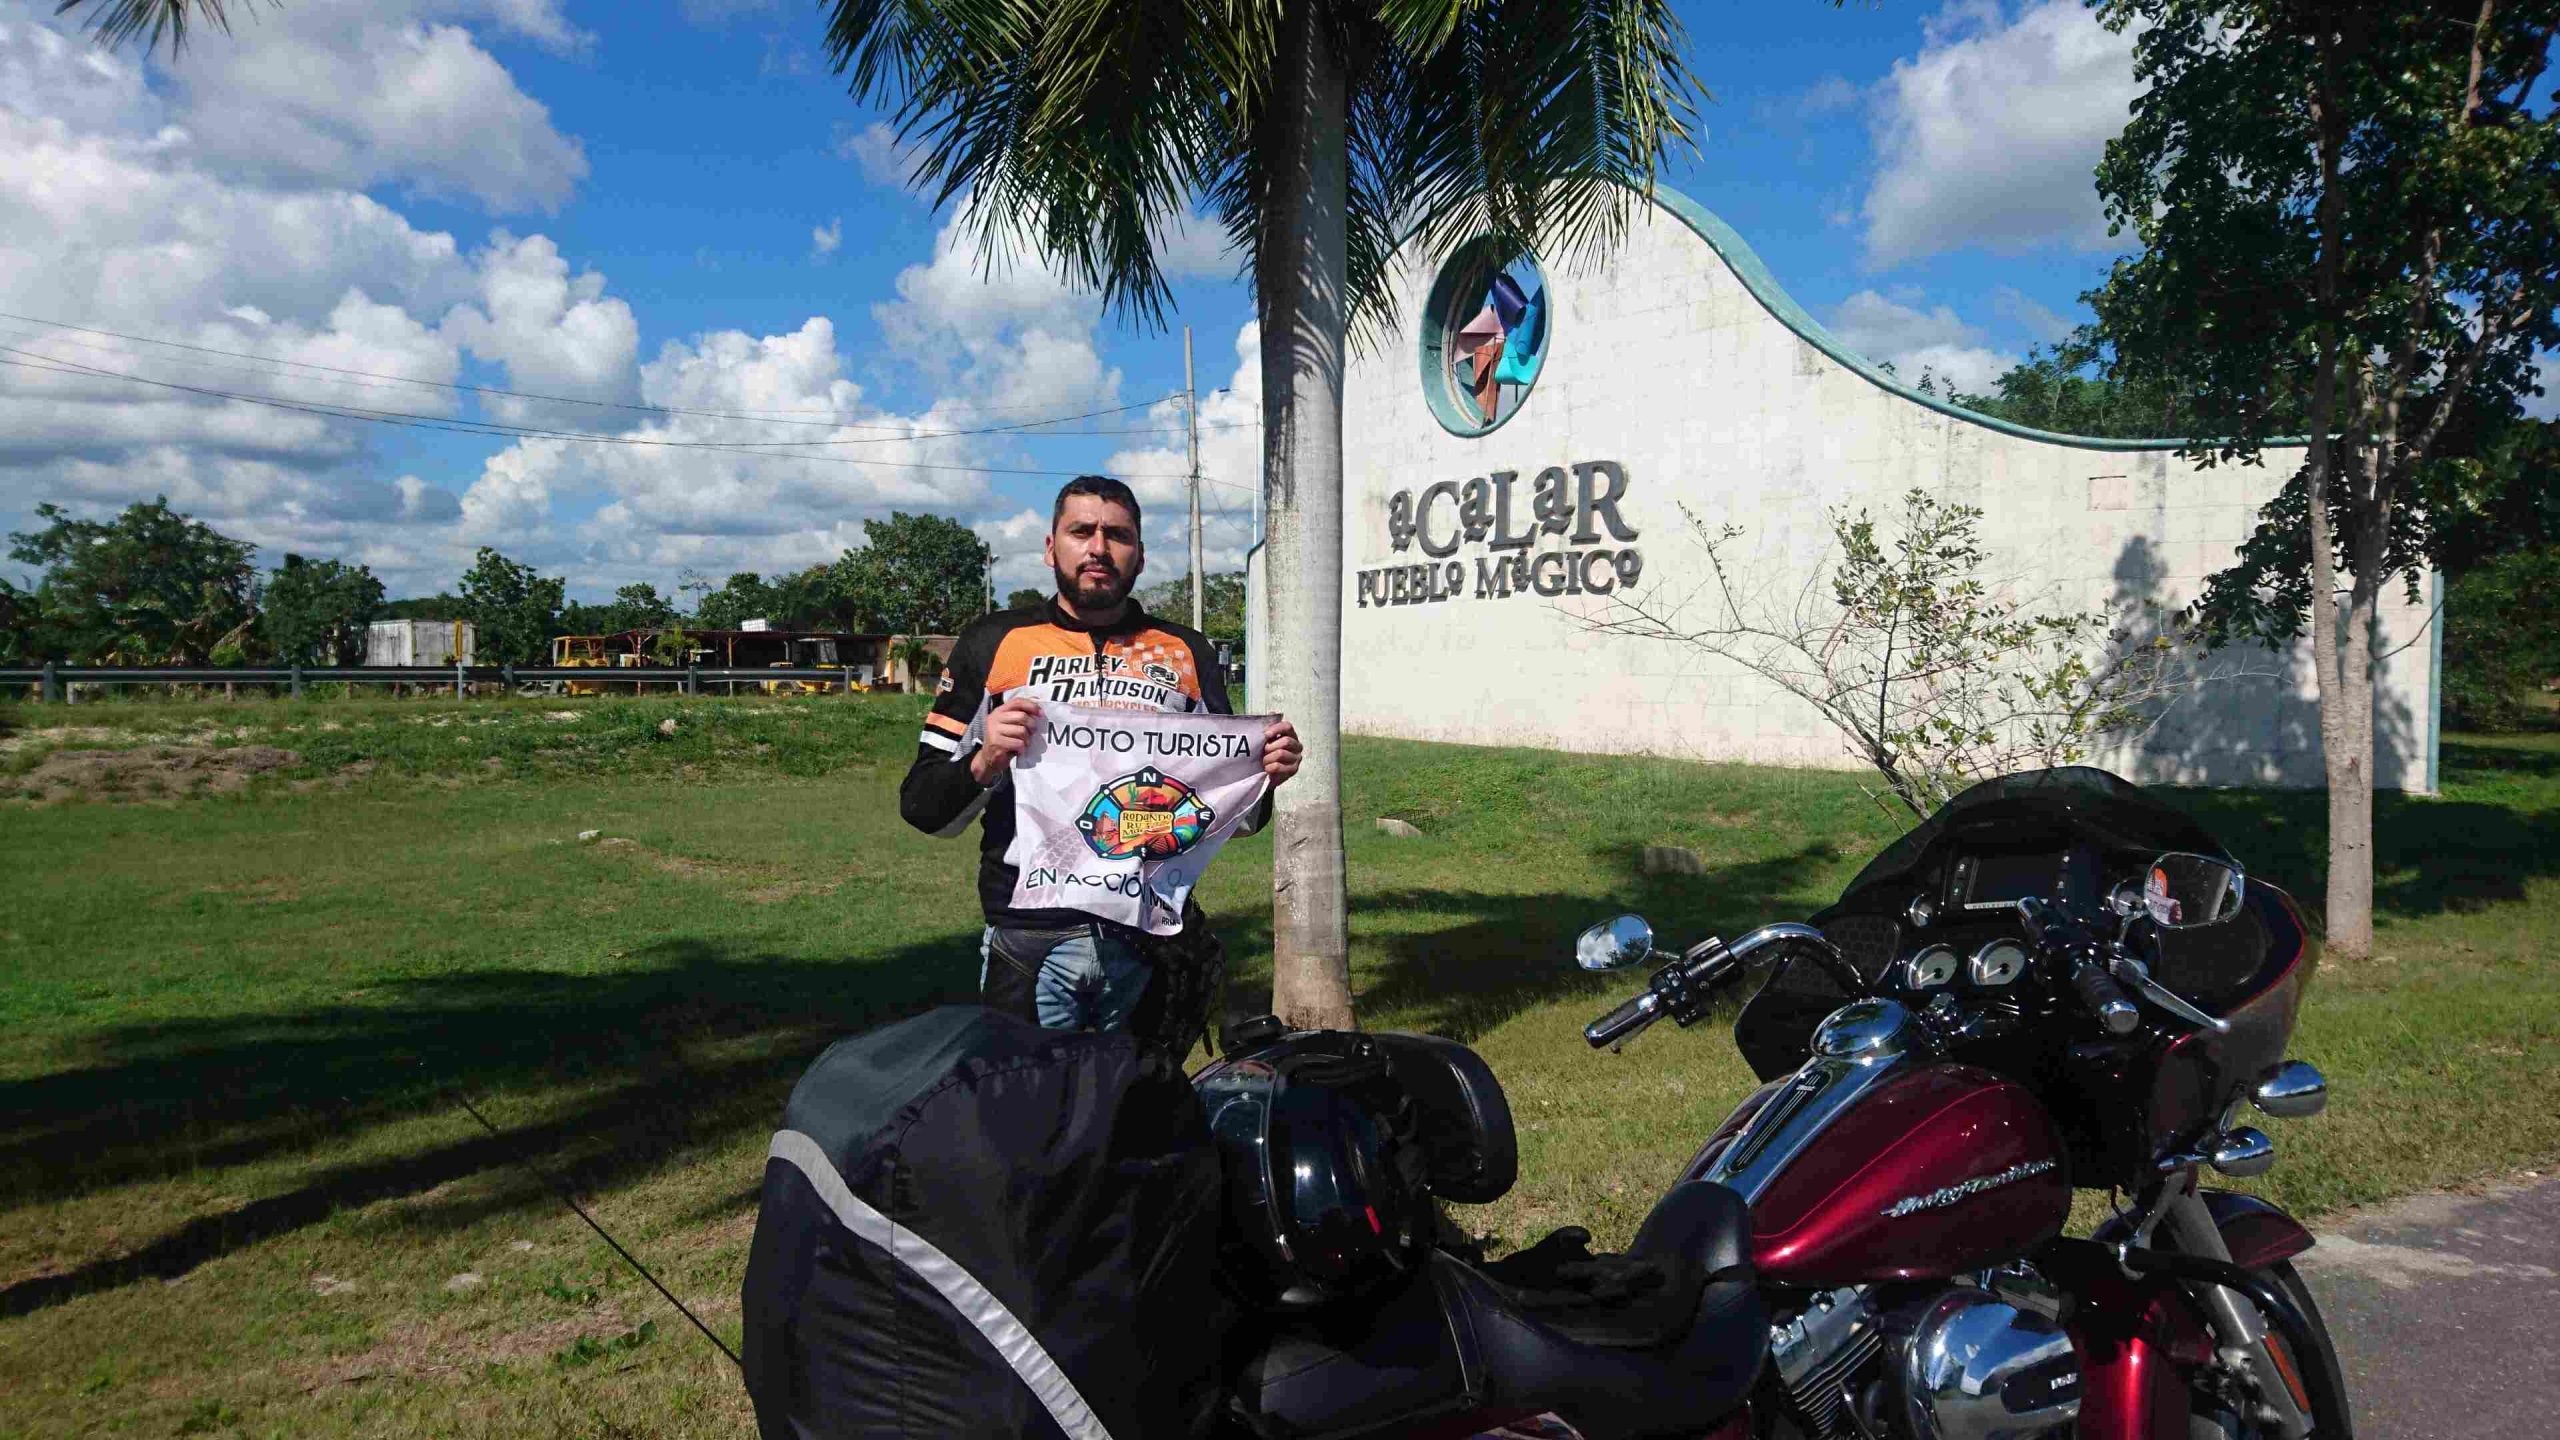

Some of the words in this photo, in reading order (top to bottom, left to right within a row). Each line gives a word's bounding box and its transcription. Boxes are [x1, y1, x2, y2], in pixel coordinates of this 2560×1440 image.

[1047, 721, 1135, 753] MOTO
[1143, 731, 1251, 758] TURISTA
[1142, 772, 1157, 783] N
[1026, 867, 1057, 889] EN
